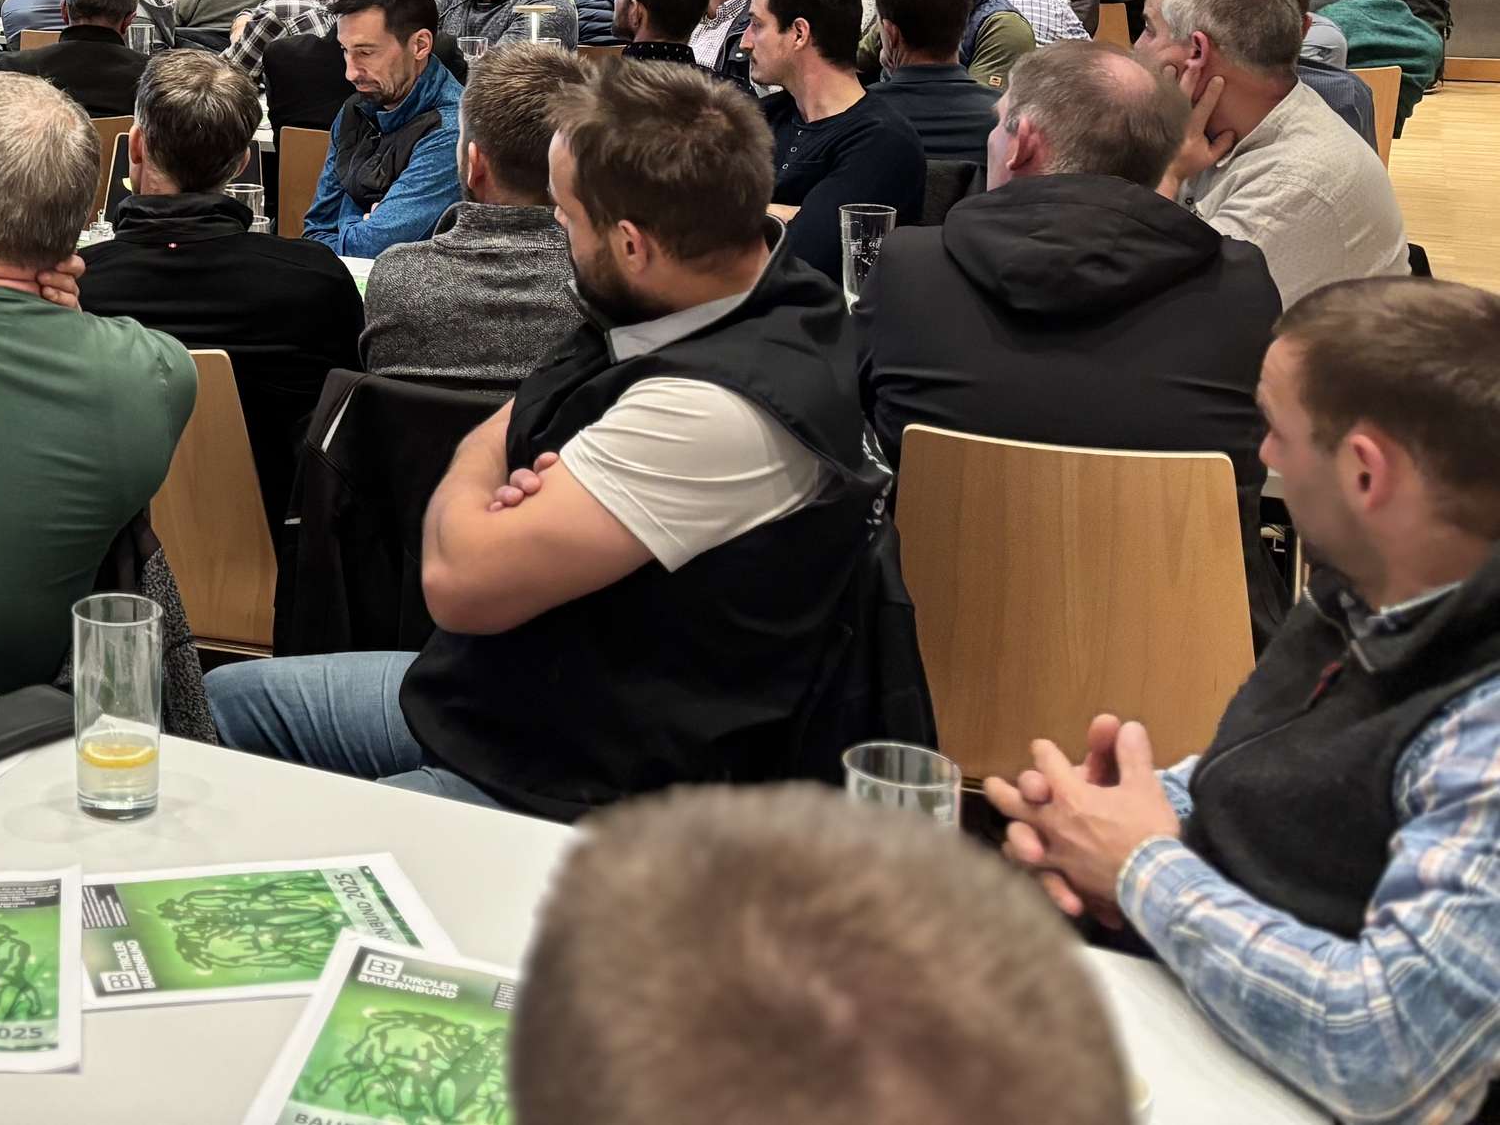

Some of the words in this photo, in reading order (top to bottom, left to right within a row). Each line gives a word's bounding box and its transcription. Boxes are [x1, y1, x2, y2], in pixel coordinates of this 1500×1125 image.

[334, 873, 366, 900] 2025
[356, 901, 394, 942] RNBUND
[112, 940, 135, 972] TIROLER
[126, 939, 157, 989] BAUERNBUND
[357, 973, 458, 1000] BAUERNBUND
[401, 973, 460, 993] TIROLER
